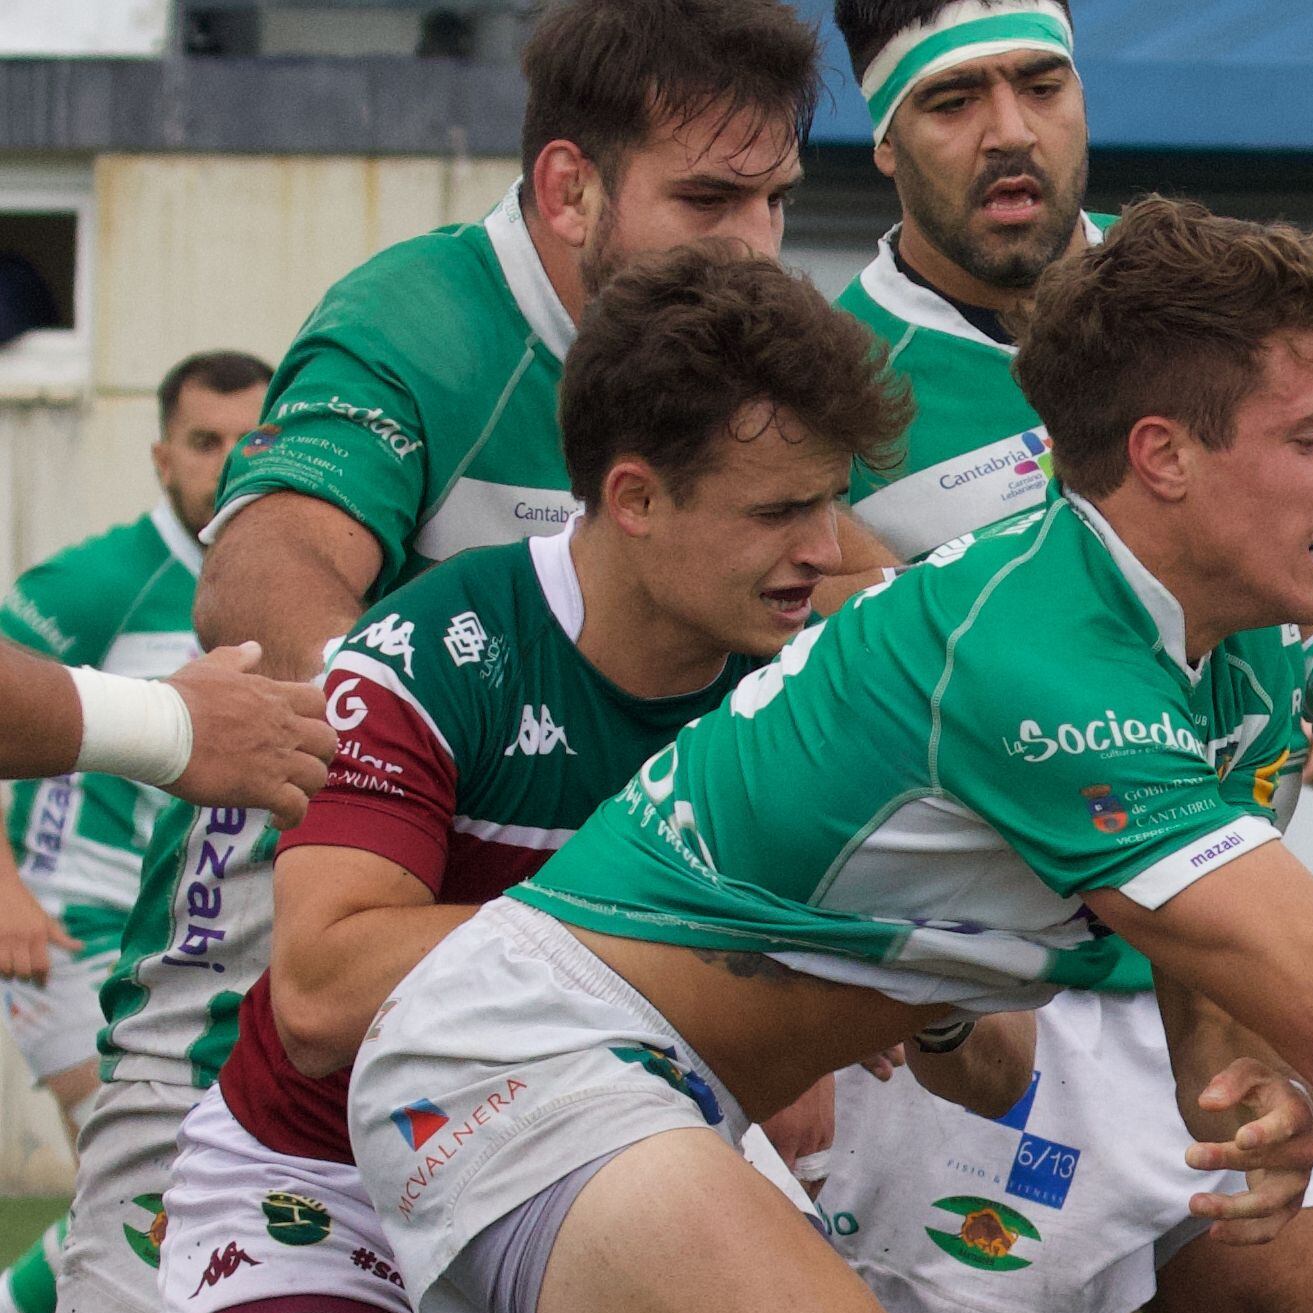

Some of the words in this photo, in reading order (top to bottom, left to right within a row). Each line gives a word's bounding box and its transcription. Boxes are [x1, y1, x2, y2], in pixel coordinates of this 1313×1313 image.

[939, 450, 1029, 490] Cantabria
[514, 502, 573, 524] Cantab
[1131, 804, 1148, 816] de
[1136, 798, 1217, 829] CANTABRIA
[1189, 831, 1246, 869] mazabi
[397, 1078, 528, 1223] MCVALNERA
[1016, 1140, 1076, 1180] 6/13
[946, 1159, 986, 1178] FISIO
